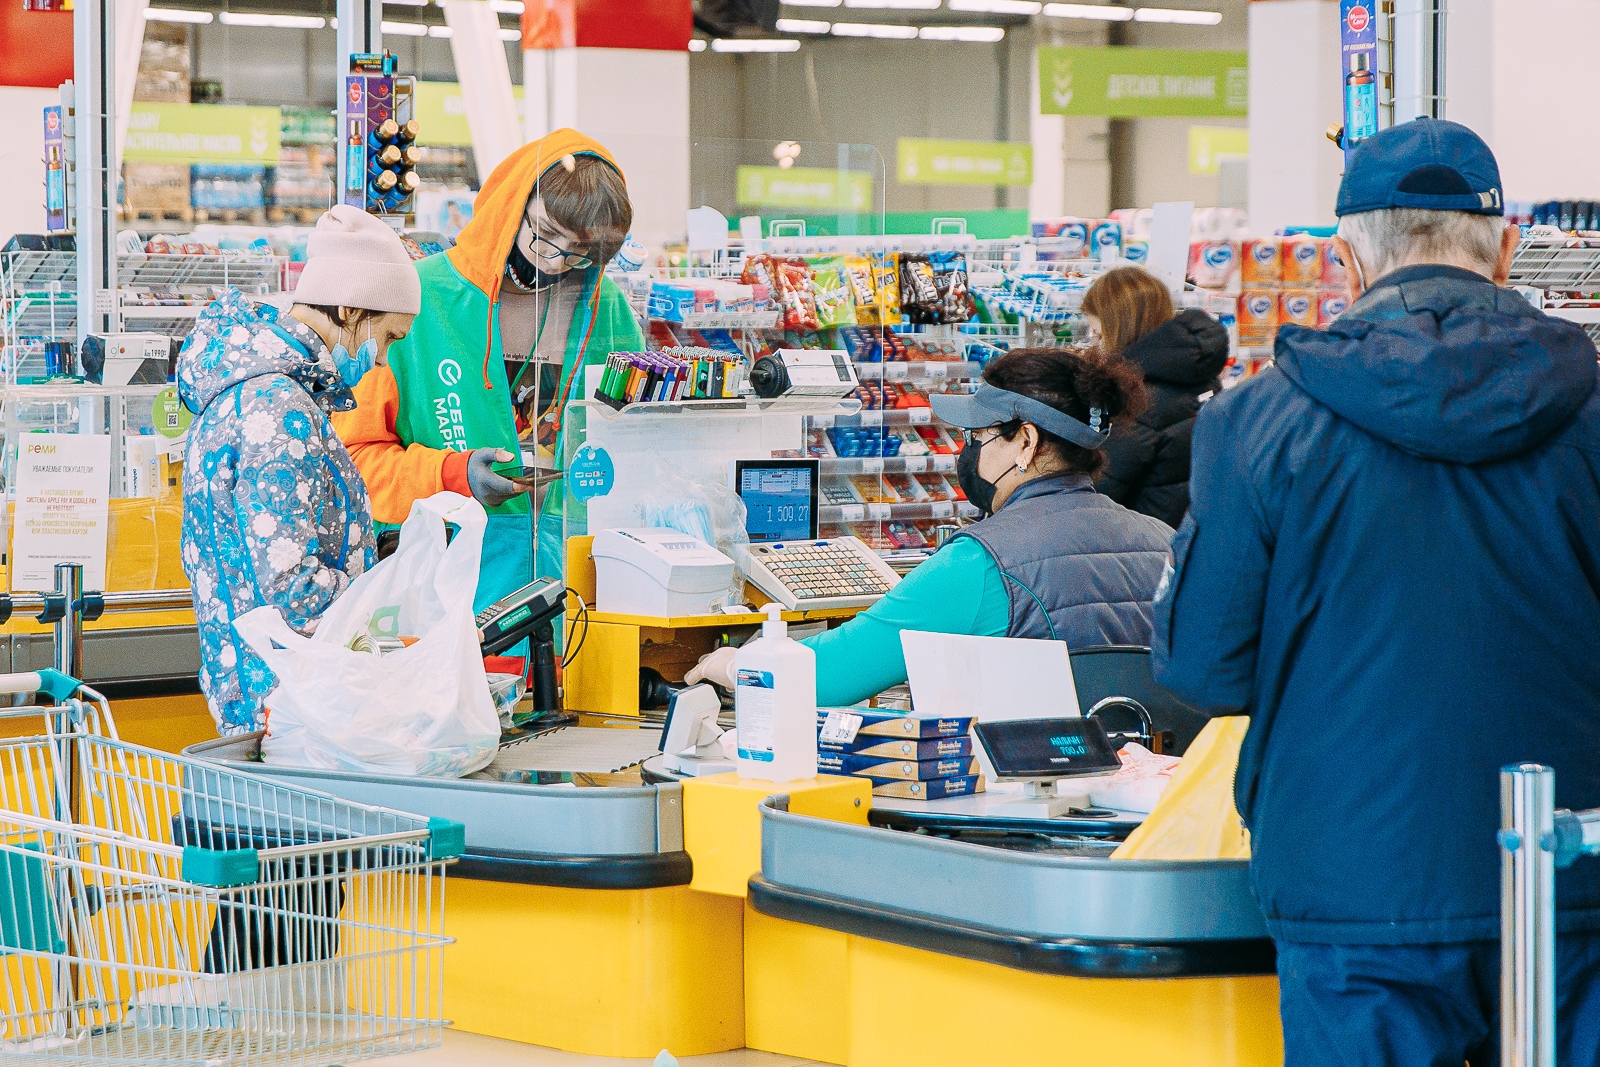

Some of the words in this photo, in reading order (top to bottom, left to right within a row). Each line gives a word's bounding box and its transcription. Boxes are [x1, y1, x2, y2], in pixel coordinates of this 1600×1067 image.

[32, 465, 61, 473] УВАЖАЕМЫЕ
[47, 496, 60, 504] APPLE
[766, 506, 773, 522] 1
[777, 505, 809, 522] 509.27
